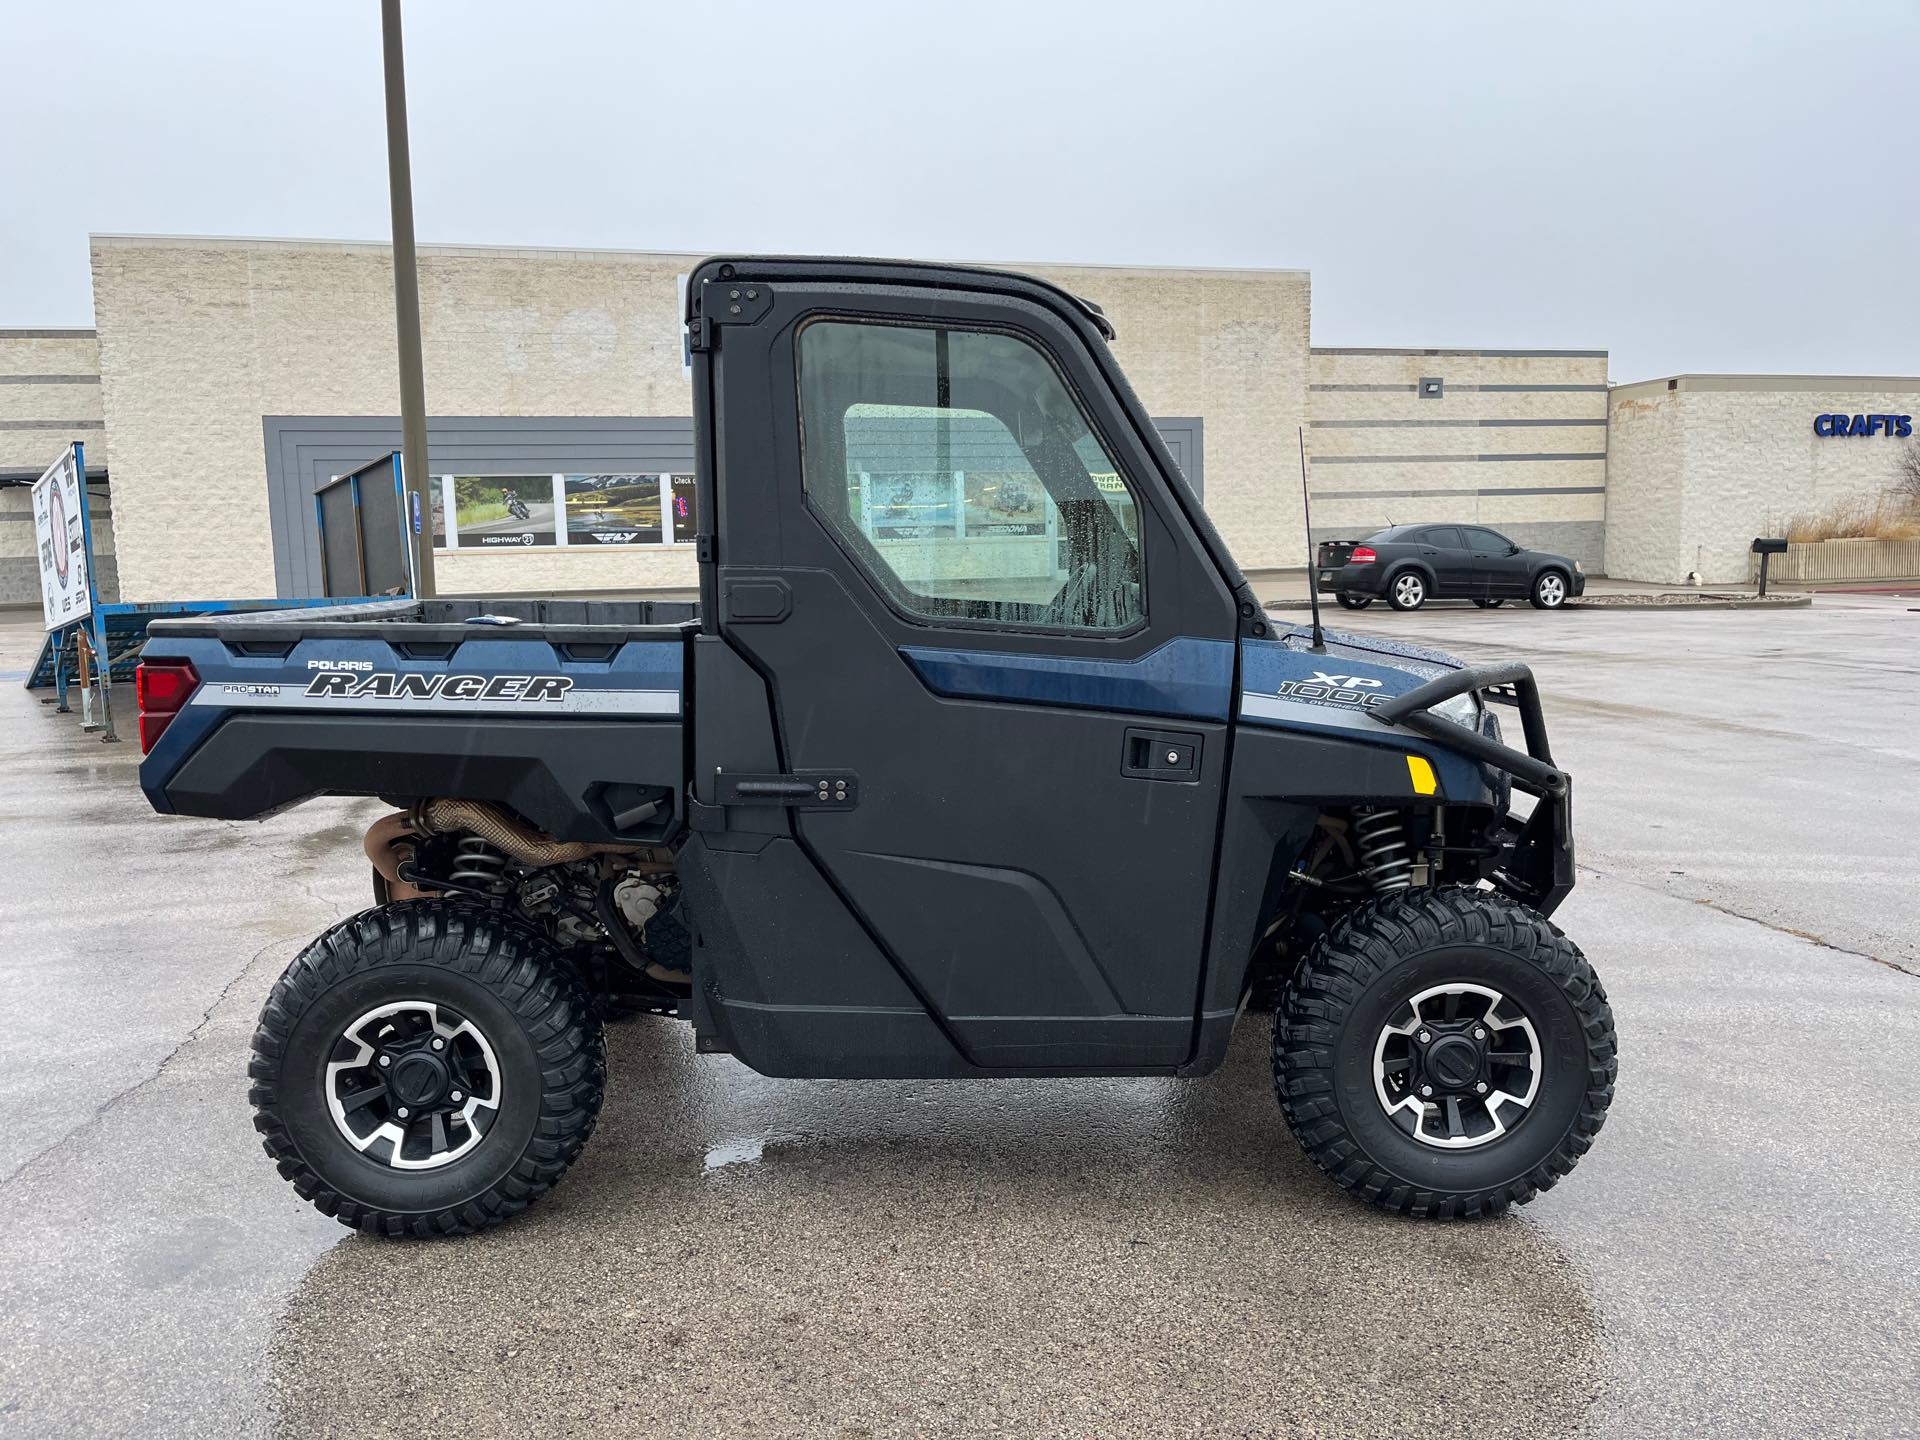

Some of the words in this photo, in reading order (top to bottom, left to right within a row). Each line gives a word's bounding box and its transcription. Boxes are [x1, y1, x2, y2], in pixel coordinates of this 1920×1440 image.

[1814, 414, 1912, 437] CRAFTS
[674, 476, 692, 485] Check
[598, 532, 639, 541] FLY
[308, 660, 373, 671] POLARIS
[1302, 671, 1384, 689] XP
[223, 685, 280, 694] PROSTAR
[304, 672, 574, 701] RANGER
[1309, 700, 1368, 712] OVERHEAD
